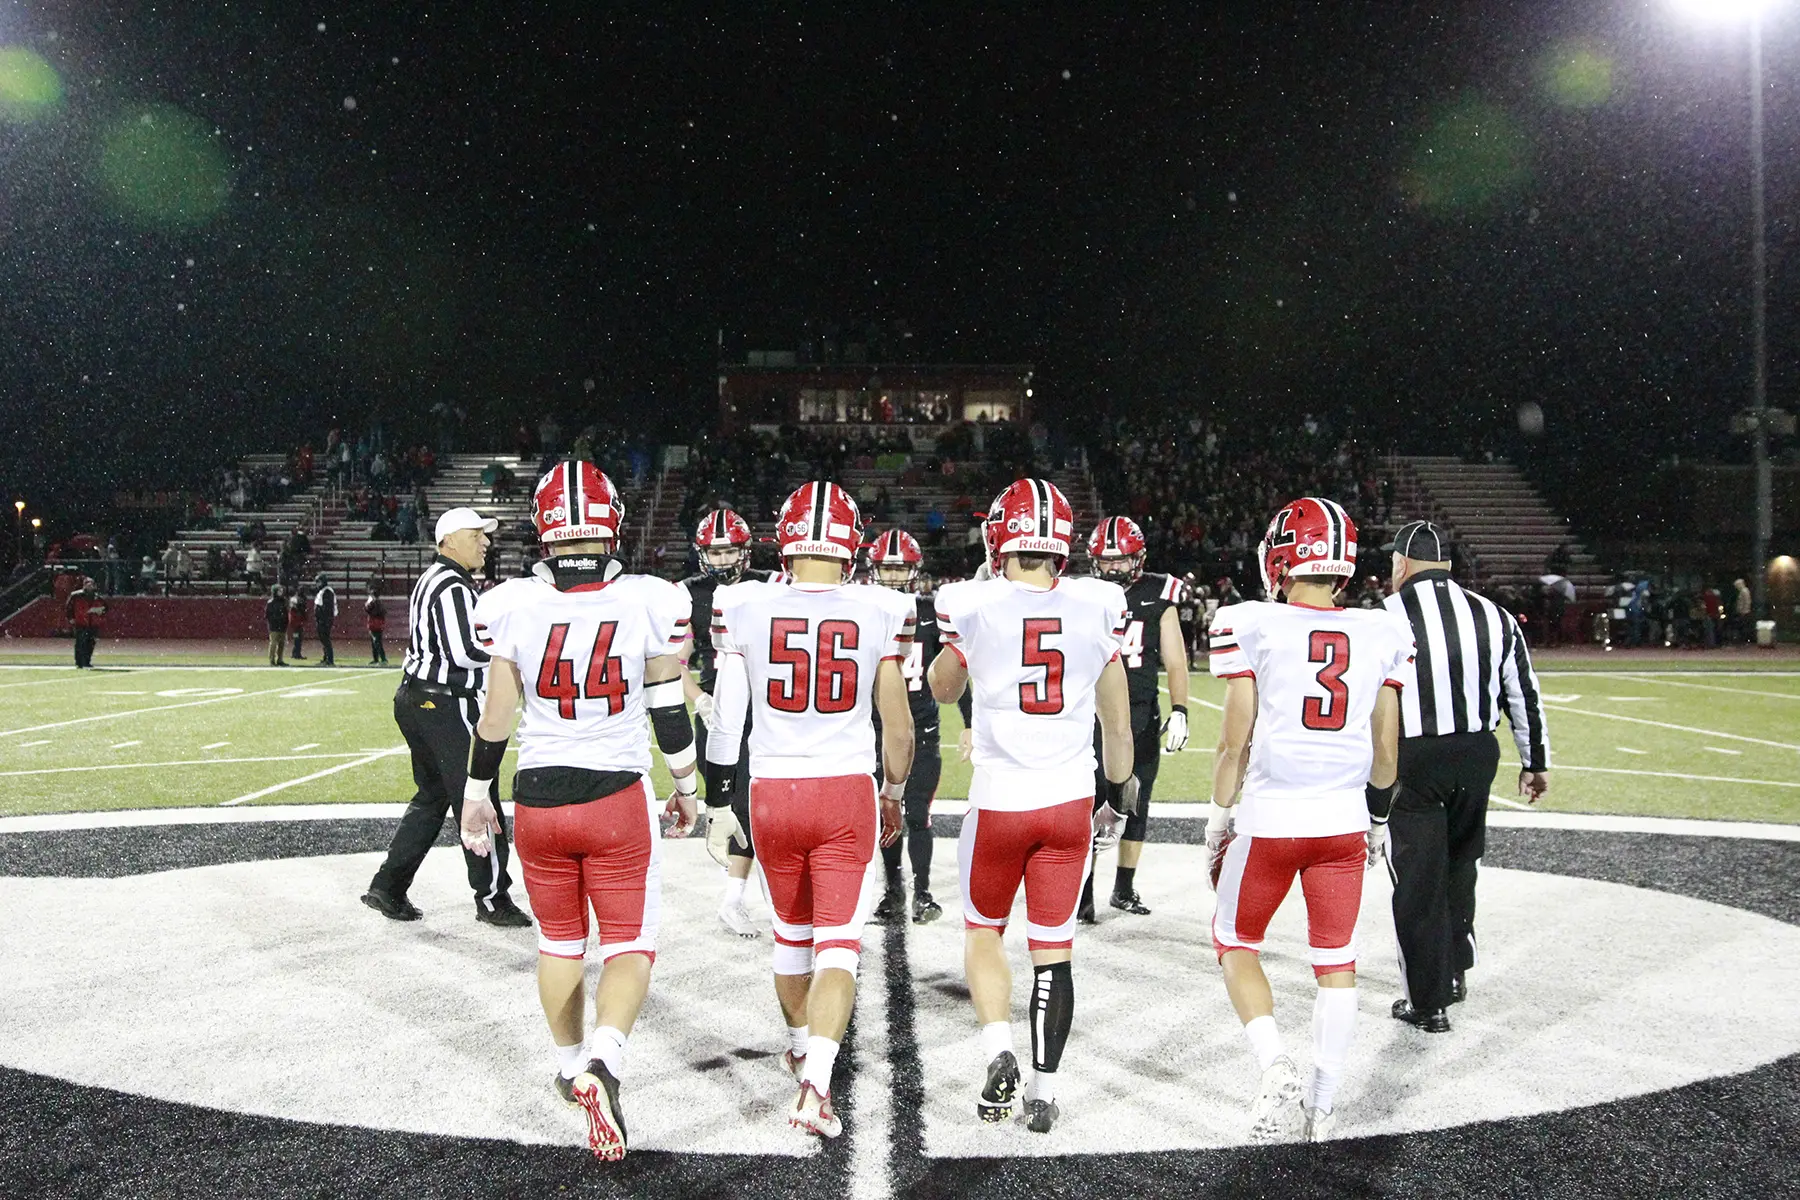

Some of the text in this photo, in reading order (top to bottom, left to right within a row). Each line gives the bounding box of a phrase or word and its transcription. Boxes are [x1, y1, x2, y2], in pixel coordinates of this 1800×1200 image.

[553, 509, 564, 519] 52
[797, 524, 806, 533] 56
[1009, 522, 1018, 530] JP
[1272, 508, 1296, 548] L
[554, 528, 599, 540] Riddell
[795, 543, 838, 554] Riddell
[1019, 540, 1063, 551] Riddell
[1298, 546, 1308, 555] JP
[1317, 543, 1323, 553] 3
[1311, 563, 1352, 574] Riddell
[536, 620, 629, 720] 44
[766, 617, 860, 714] 56
[1018, 617, 1065, 715] 5
[1301, 630, 1351, 731] 3
